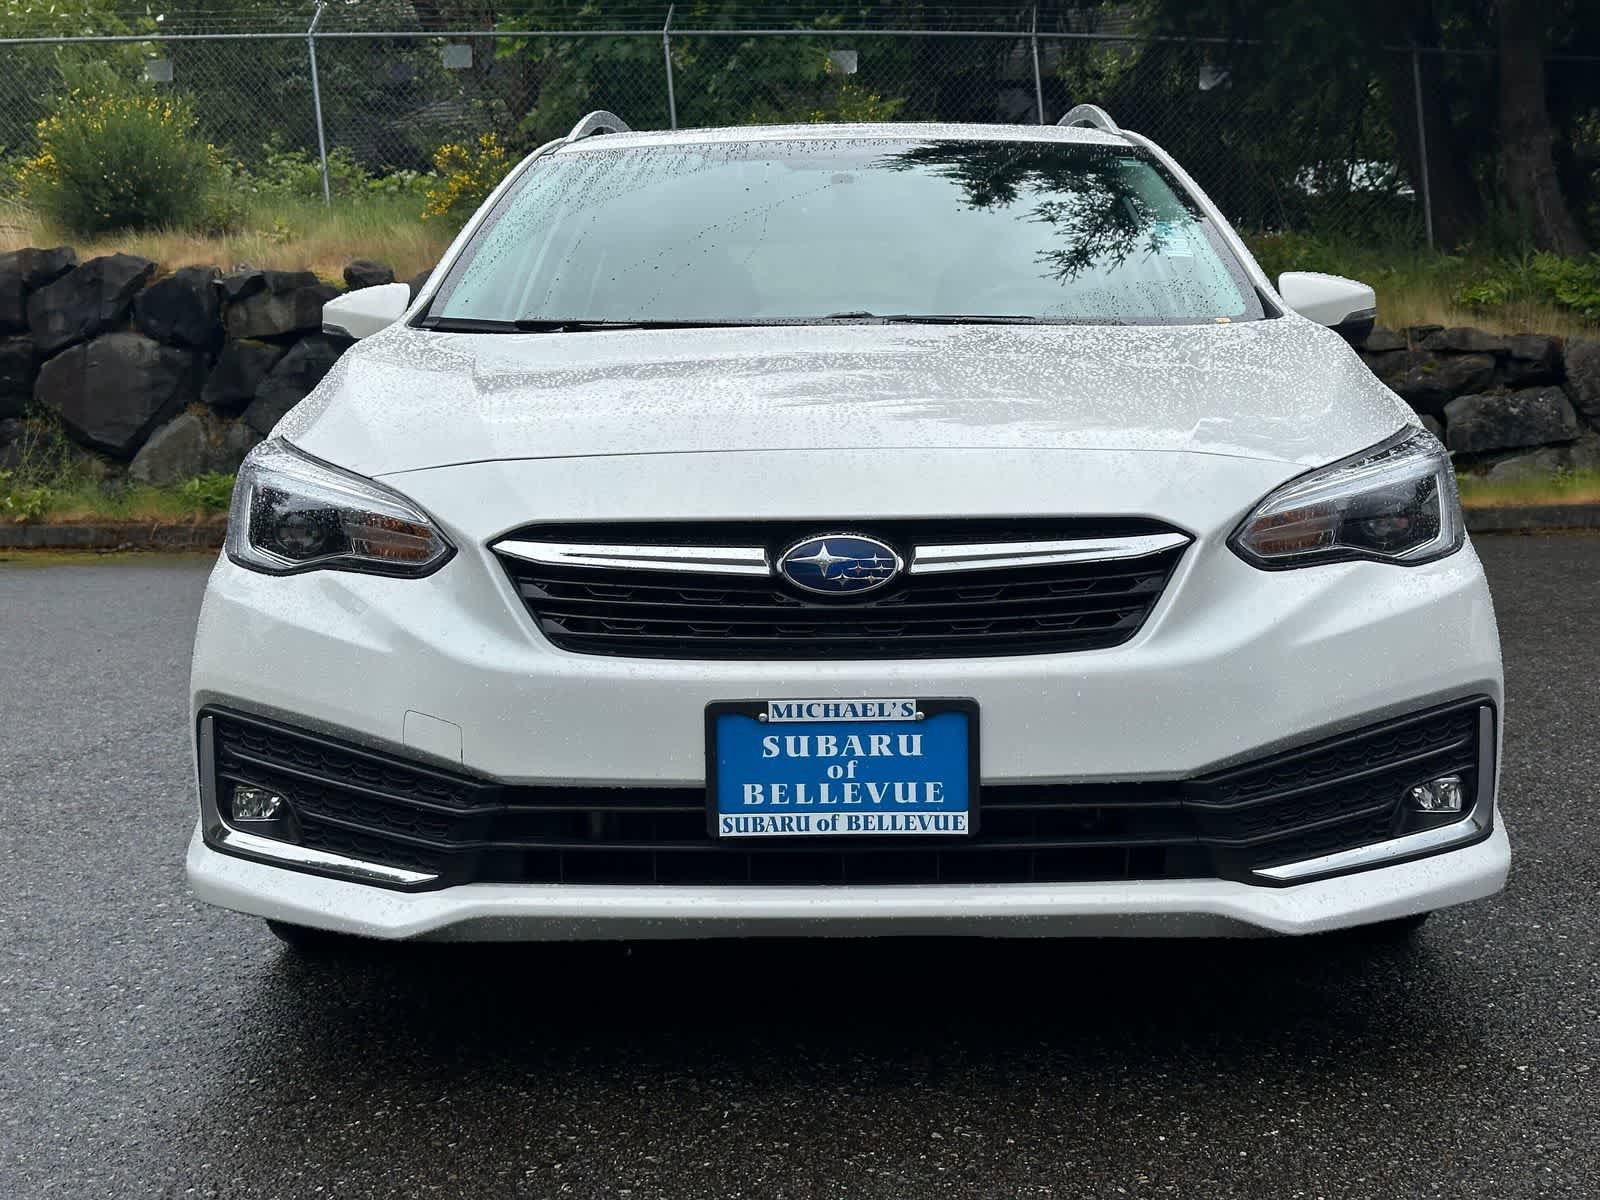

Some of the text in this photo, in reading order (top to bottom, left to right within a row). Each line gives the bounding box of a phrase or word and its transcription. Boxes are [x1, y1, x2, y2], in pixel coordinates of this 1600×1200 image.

[771, 702, 914, 719] MICHAEL'S
[762, 734, 923, 758] SUBARU
[827, 760, 858, 779] of
[743, 782, 944, 805] BELLEVUE
[722, 814, 966, 833] SUBARU of BELLEVUE
